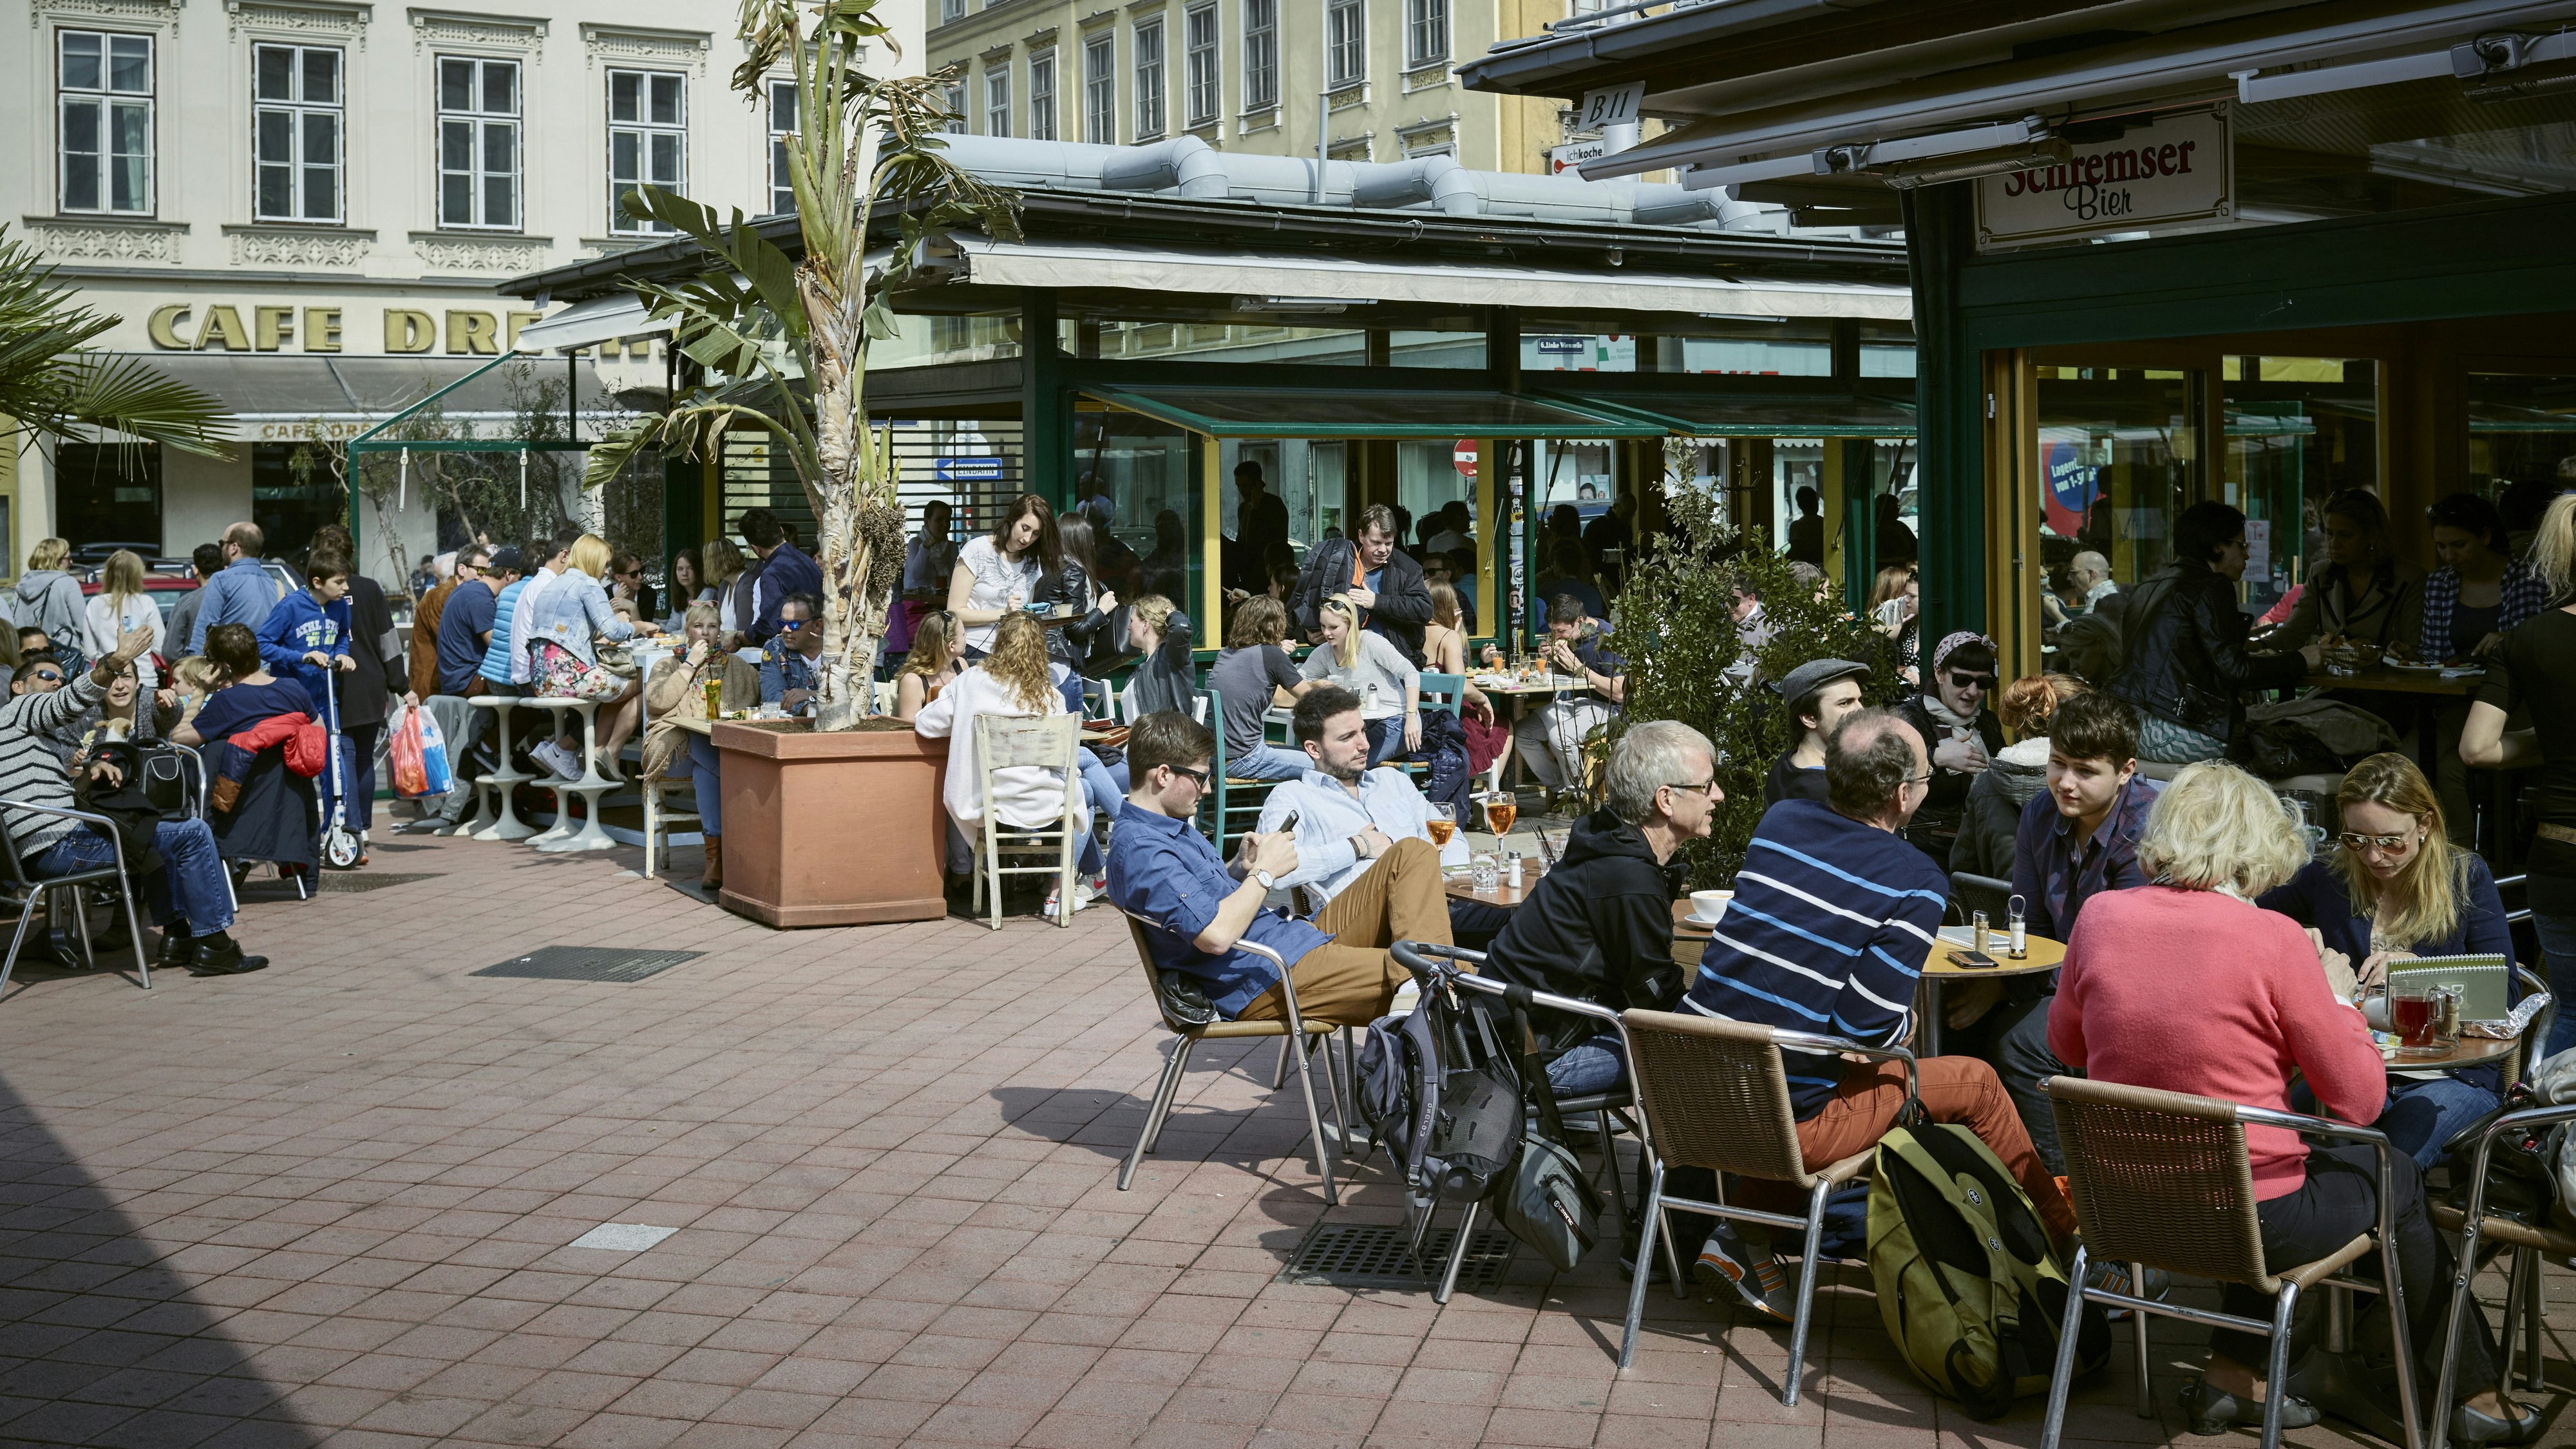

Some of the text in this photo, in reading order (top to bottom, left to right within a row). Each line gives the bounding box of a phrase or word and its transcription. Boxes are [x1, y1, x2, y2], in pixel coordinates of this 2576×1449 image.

[2064, 182, 2132, 220] Bier
[147, 303, 341, 352] CAFE
[262, 424, 317, 438] CAFE
[958, 465, 995, 475] EINBAHN
[1558, 1205, 1573, 1226] tamrac
